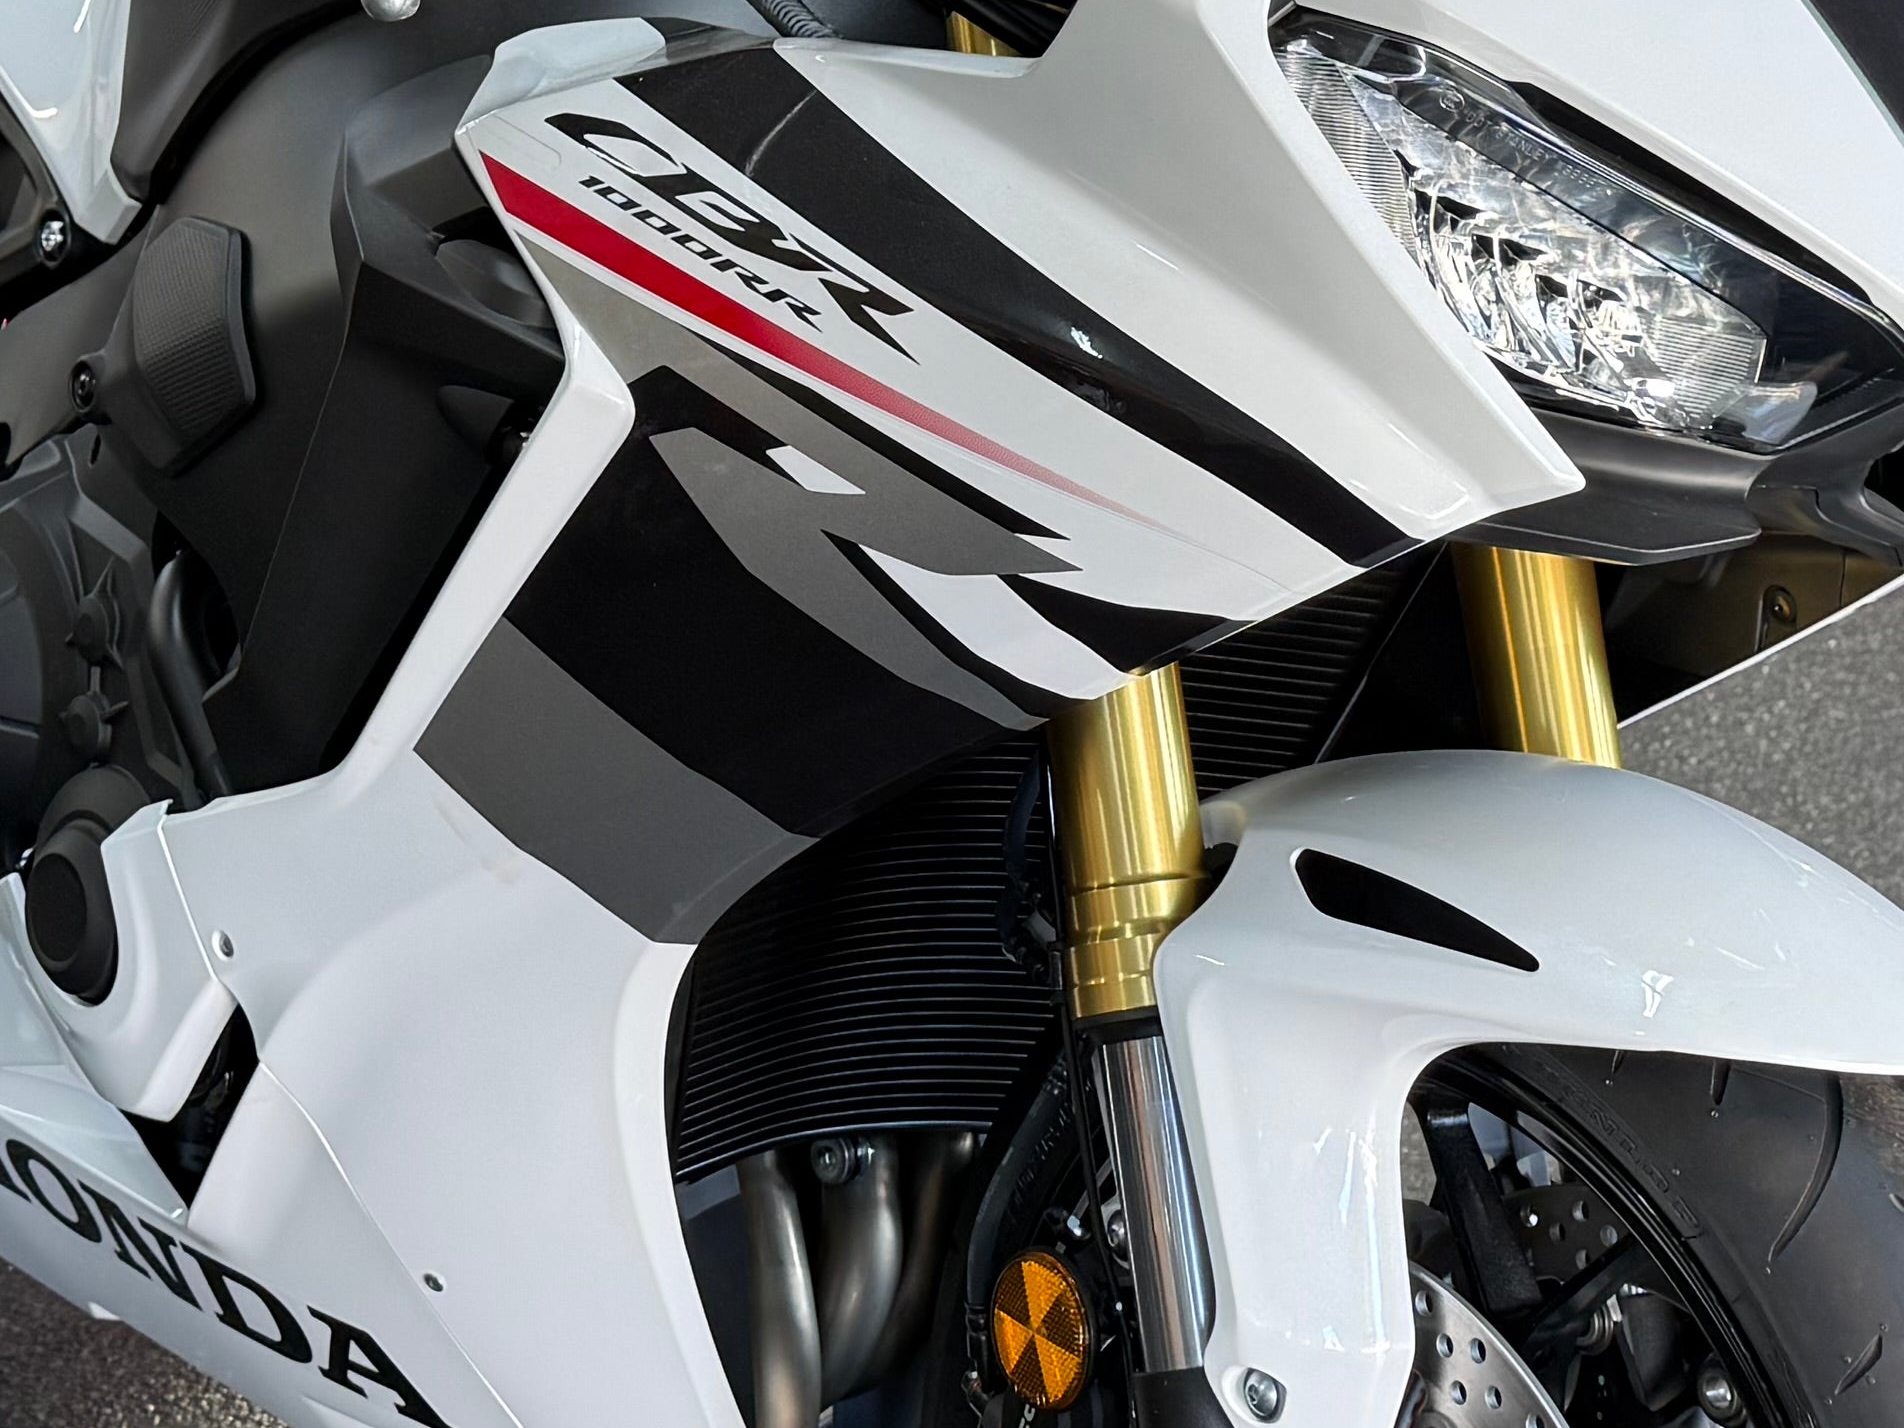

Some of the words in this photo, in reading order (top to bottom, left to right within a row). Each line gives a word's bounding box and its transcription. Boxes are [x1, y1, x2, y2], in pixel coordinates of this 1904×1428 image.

[1495, 127, 1553, 163] STANLEY
[544, 113, 921, 366] CBR
[578, 175, 823, 333] 1000RR
